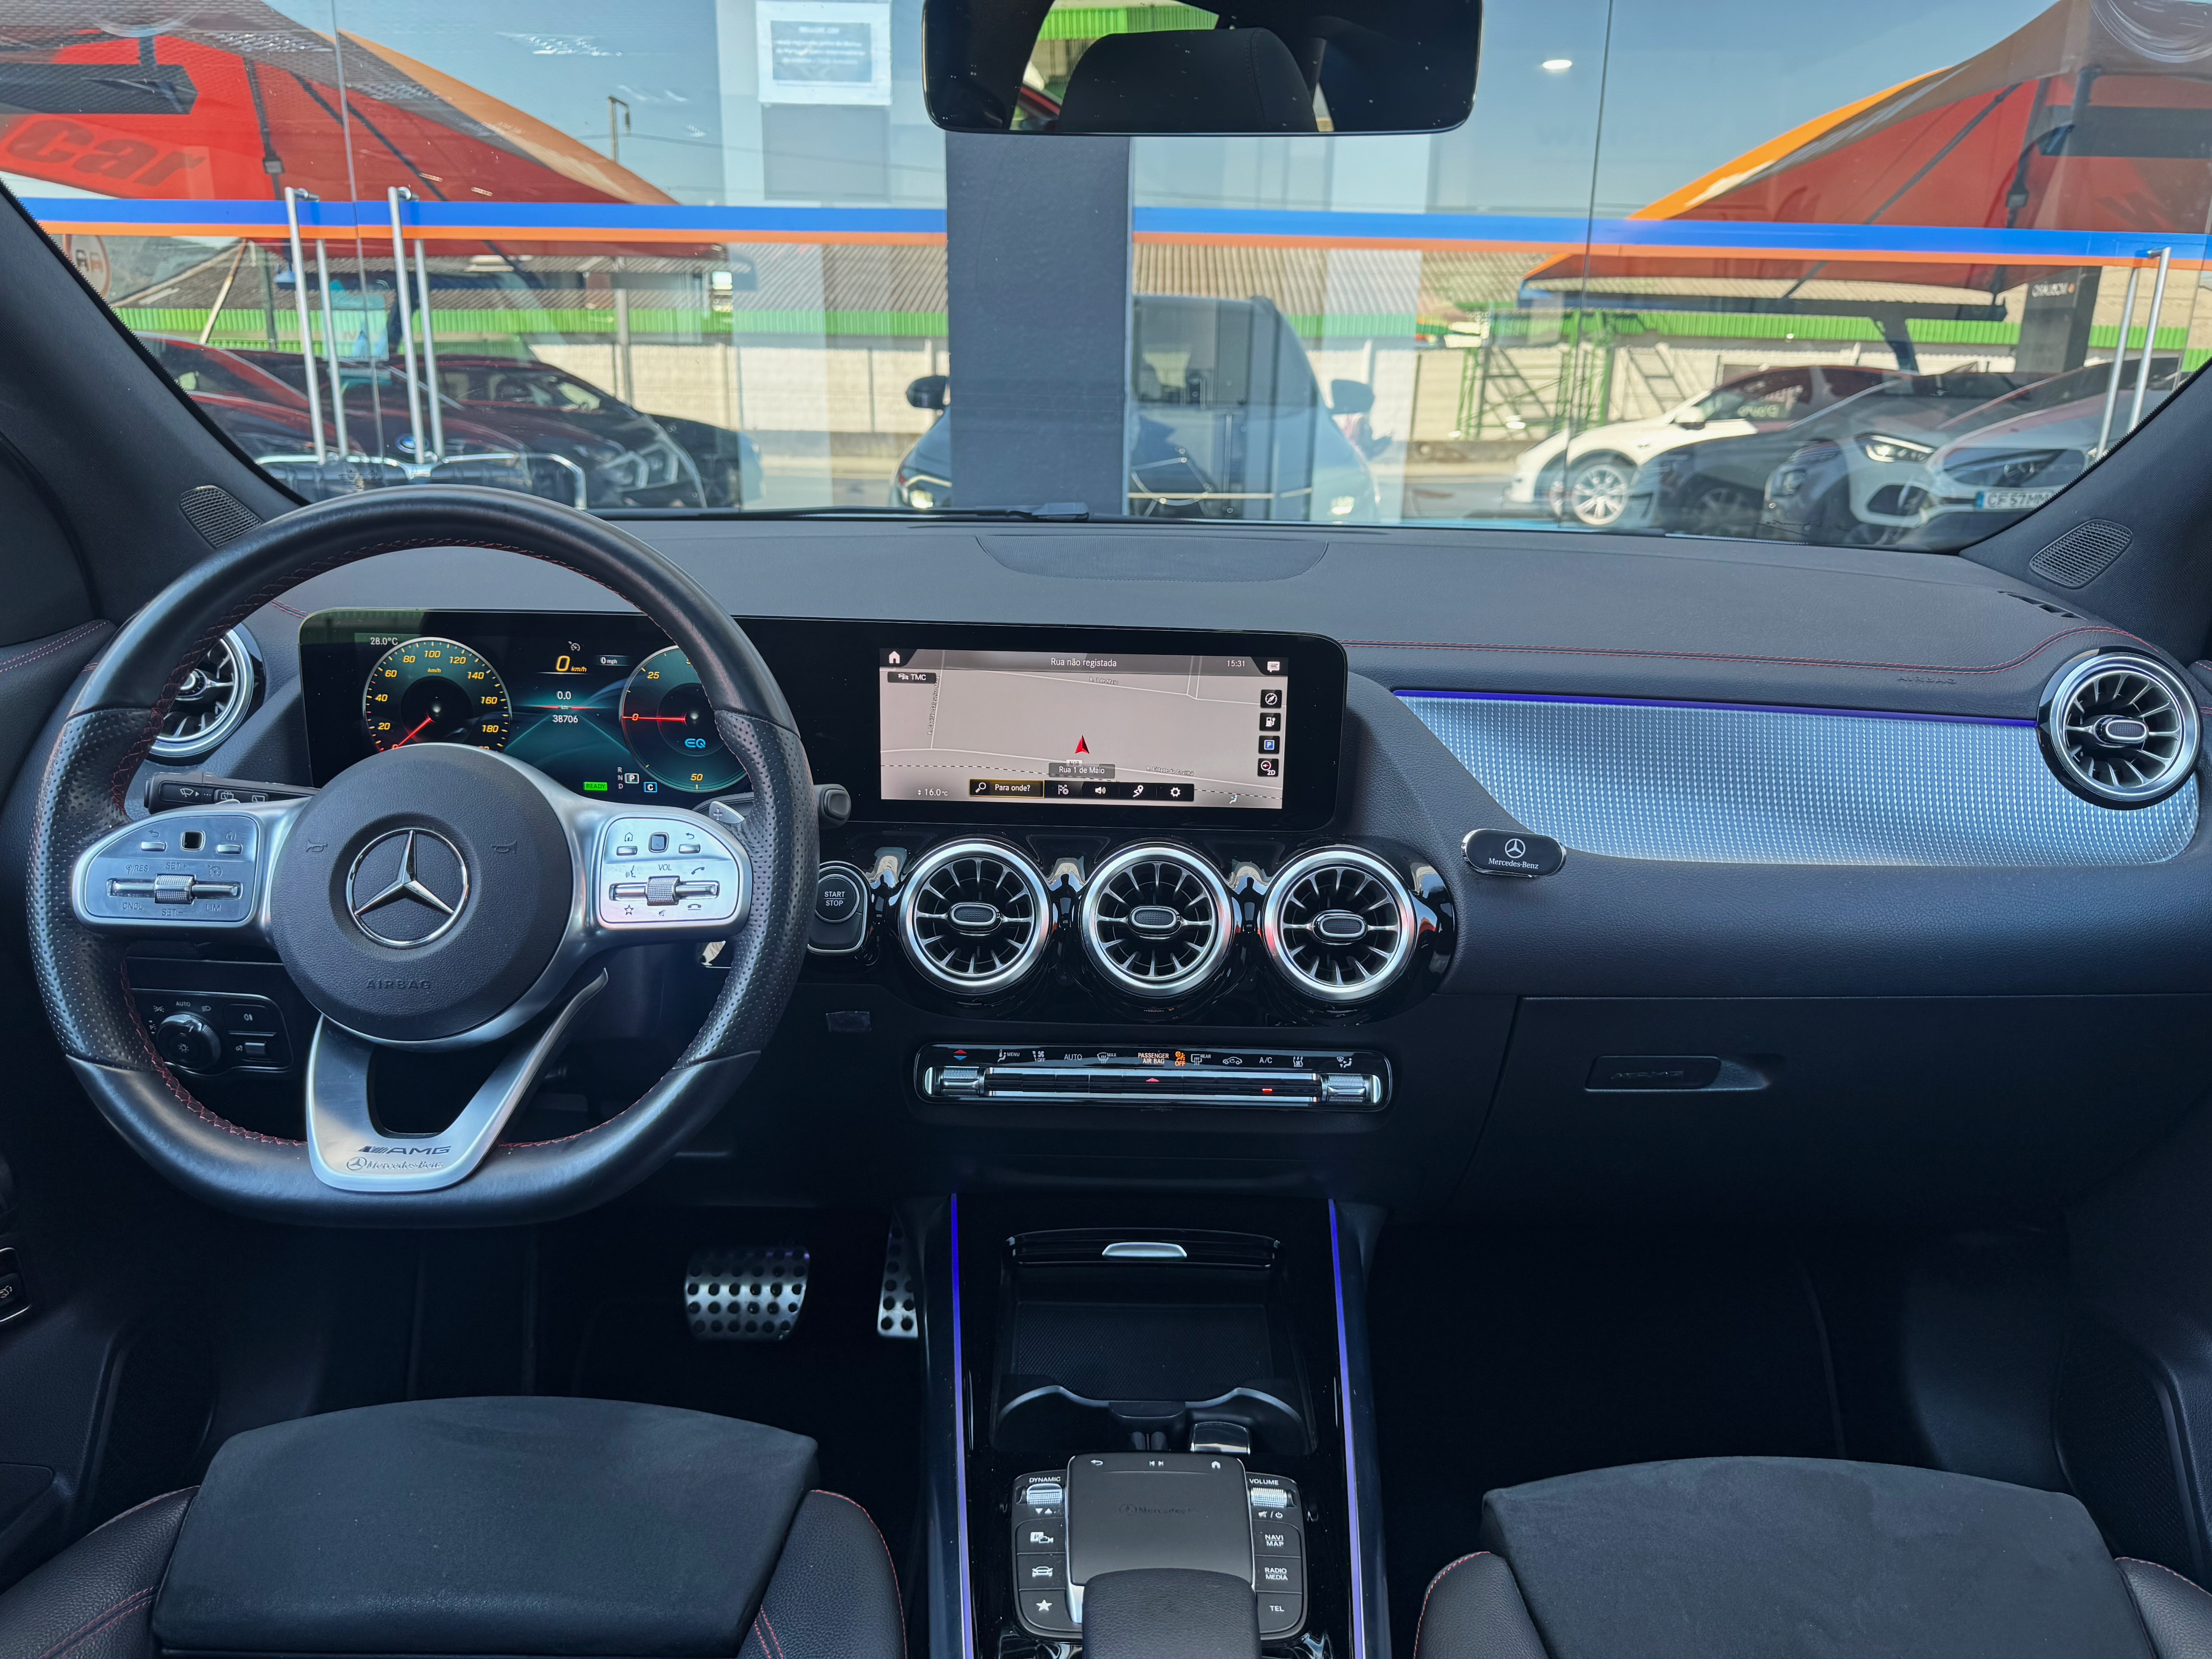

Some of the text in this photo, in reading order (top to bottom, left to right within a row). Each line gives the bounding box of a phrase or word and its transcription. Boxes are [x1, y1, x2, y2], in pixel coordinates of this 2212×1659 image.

[370, 637, 398, 645] 28.0°C
[556, 656, 570, 671] 0
[1083, 659, 1117, 668] registada
[557, 691, 572, 700] 0.0
[553, 715, 578, 723] 38706
[685, 738, 706, 748] EQ
[658, 863, 672, 871] VOL
[1488, 858, 1539, 869] Mercedes-Benz
[122, 902, 143, 911] CNCL
[206, 904, 221, 912] LIM
[366, 979, 431, 990] AIRBAG
[386, 1146, 451, 1155] AMG
[367, 1160, 443, 1170] Mercedes-Benz
